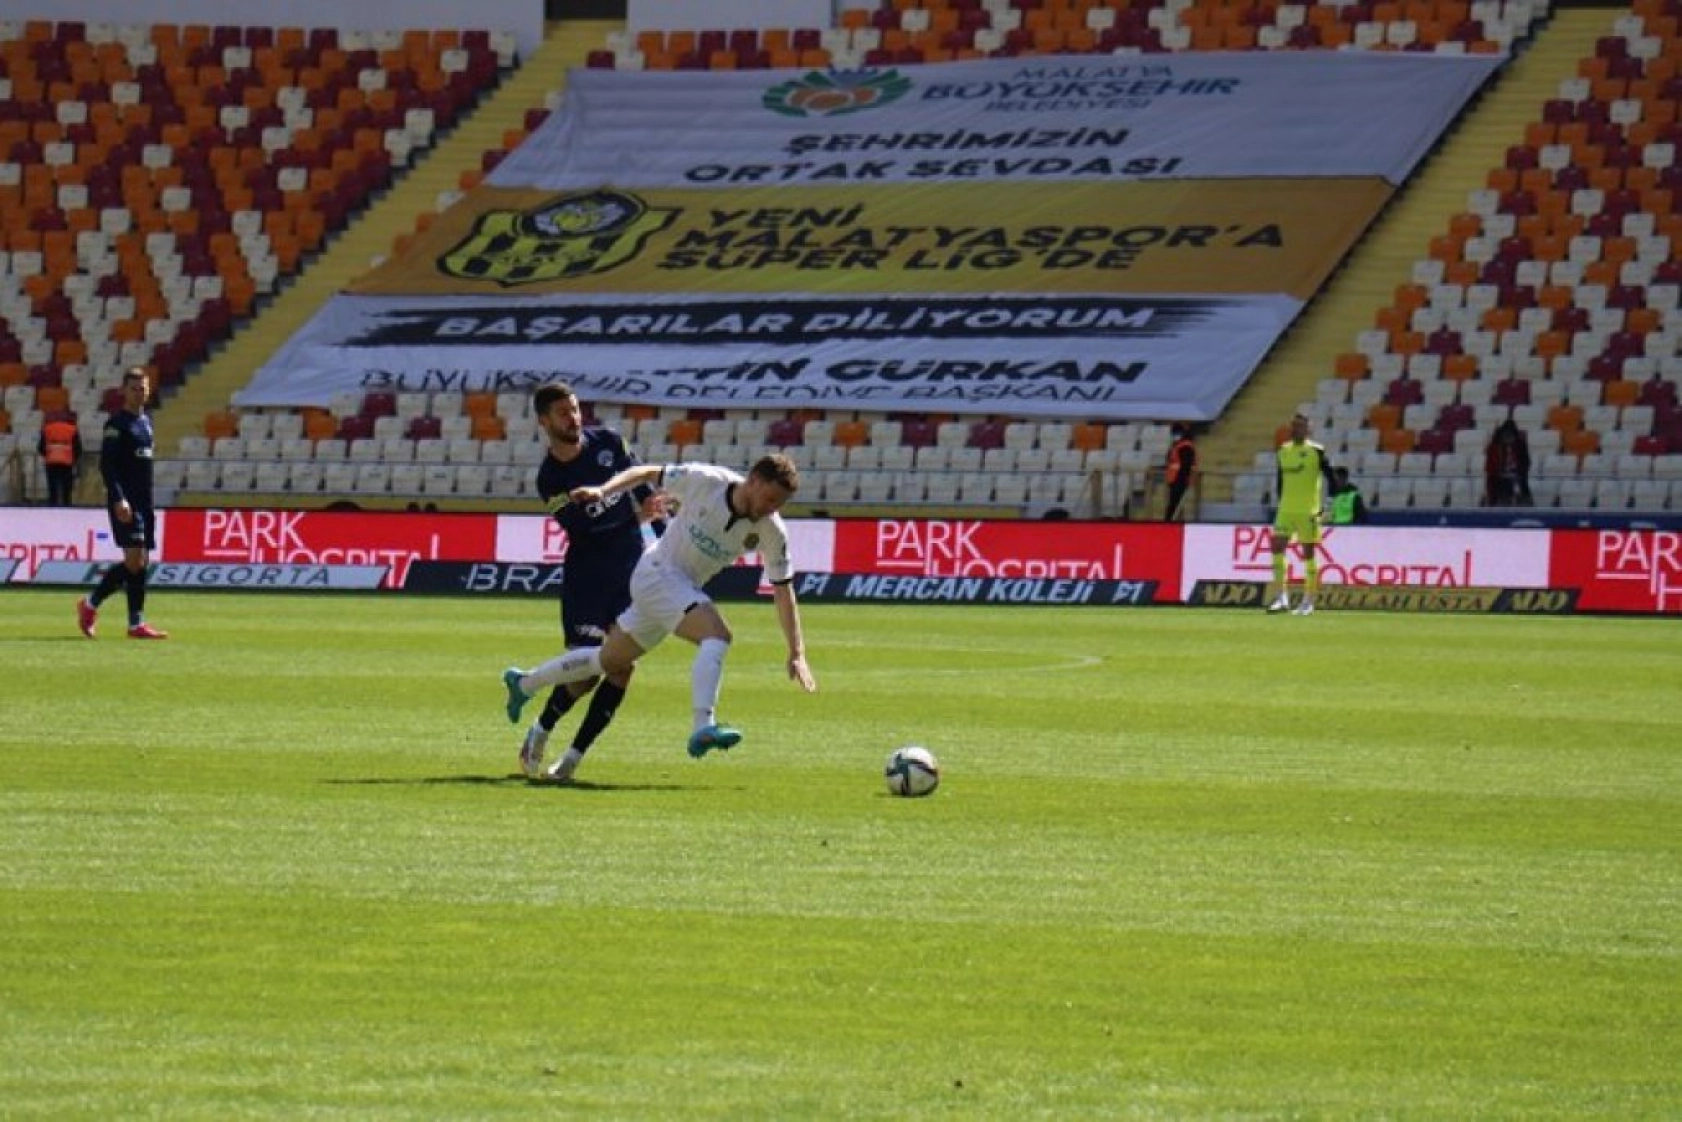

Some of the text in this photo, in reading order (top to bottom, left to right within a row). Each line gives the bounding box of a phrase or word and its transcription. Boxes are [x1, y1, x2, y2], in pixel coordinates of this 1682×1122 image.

[784, 128, 1129, 156] ŞEHRİMİZİN
[684, 156, 1182, 182] ORTAK SEVDASI
[708, 202, 864, 228] YENİ
[437, 308, 1153, 340] BAŞARILAR DİLİYORUM
[203, 511, 308, 549] PARK
[876, 520, 982, 559] PARK
[465, 563, 564, 592] BRA
[845, 574, 1096, 601] MERCAN KOLEJİ
